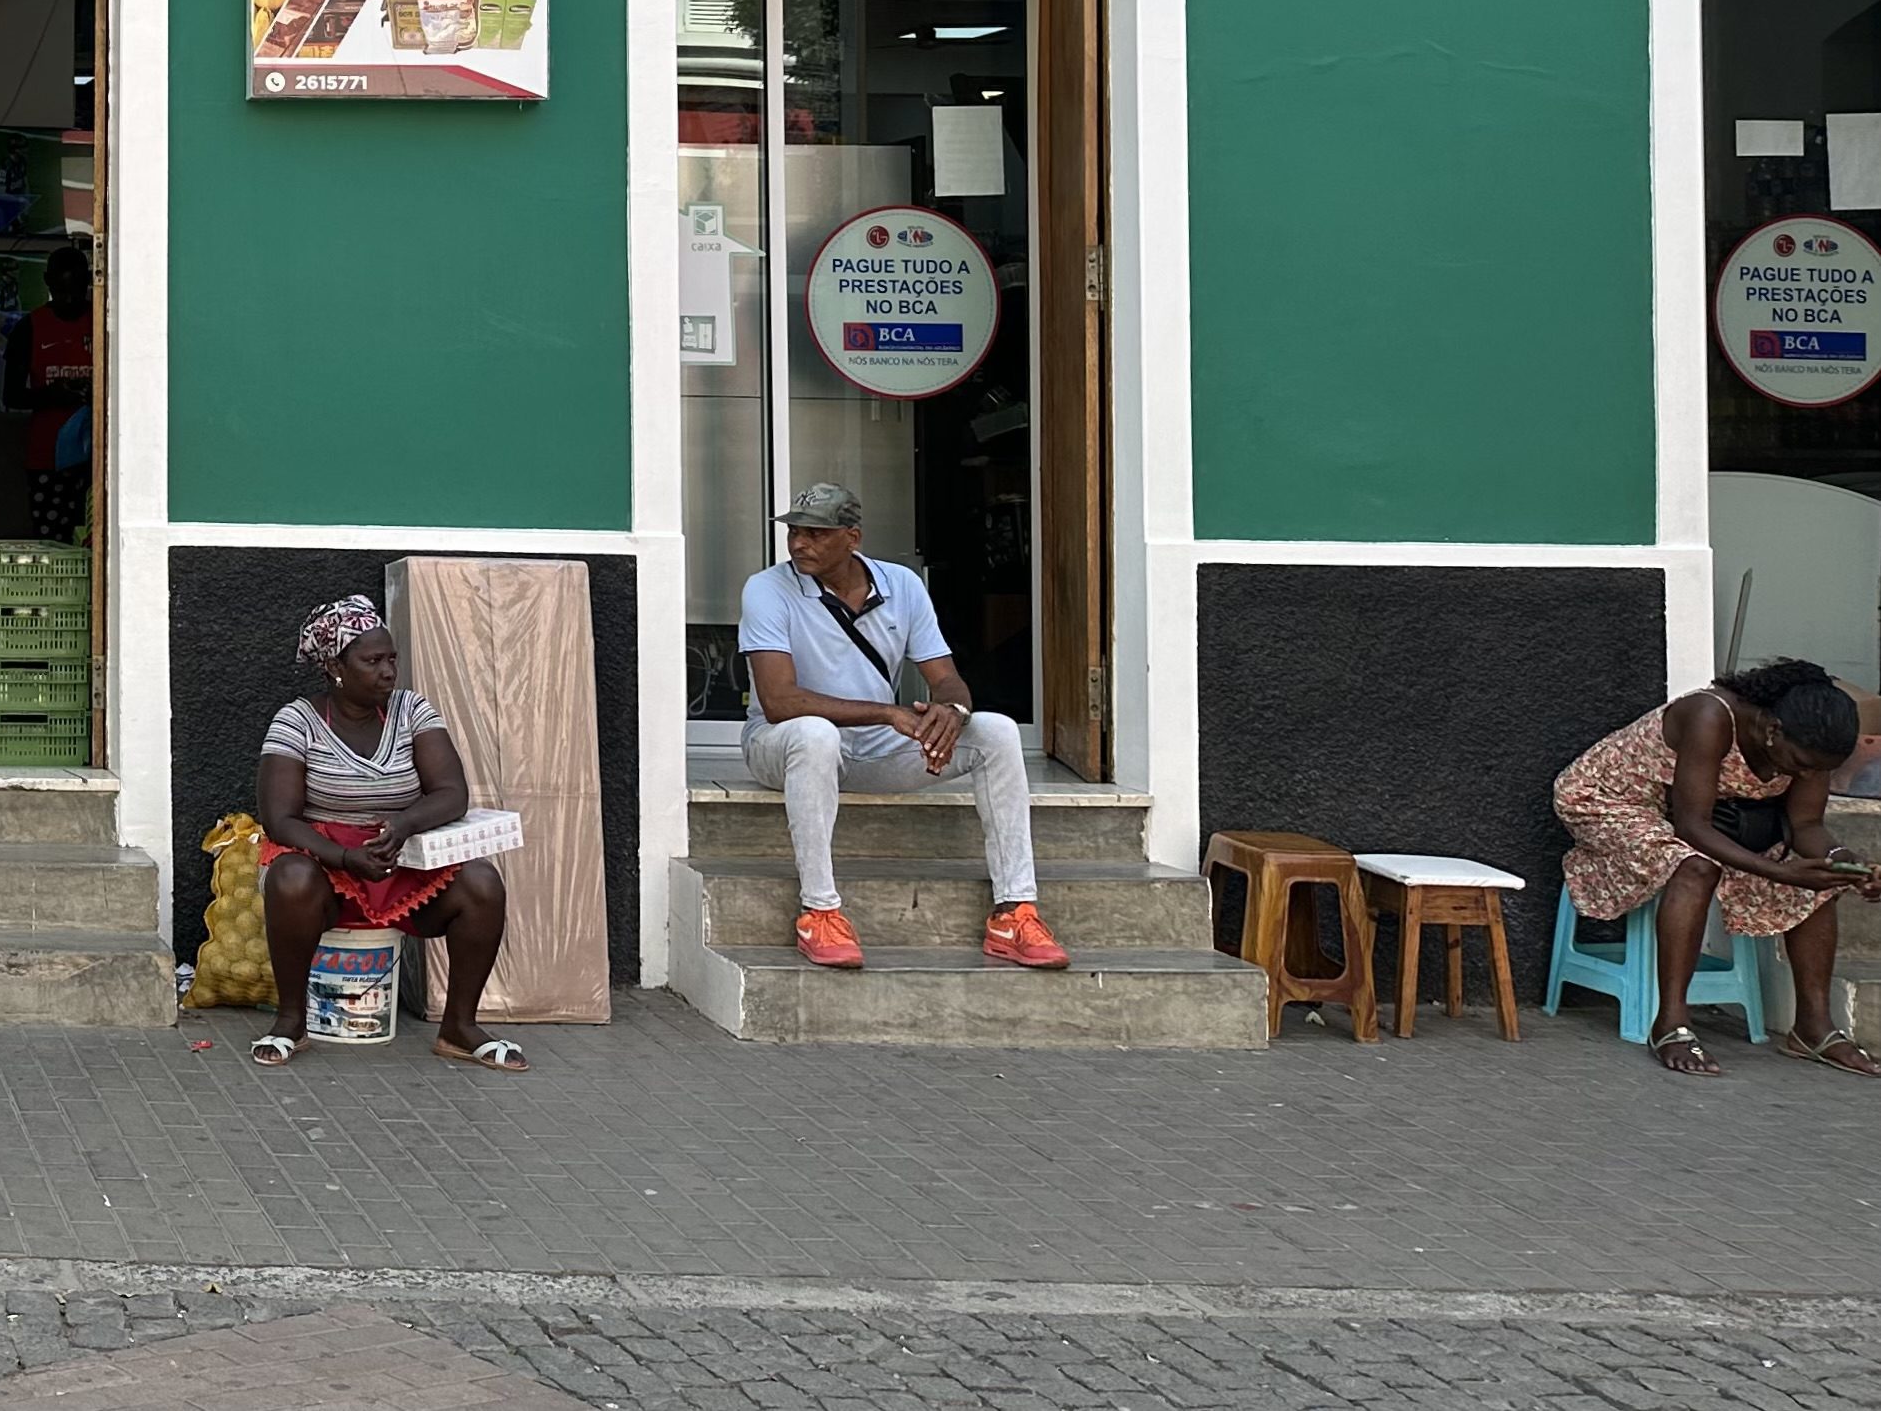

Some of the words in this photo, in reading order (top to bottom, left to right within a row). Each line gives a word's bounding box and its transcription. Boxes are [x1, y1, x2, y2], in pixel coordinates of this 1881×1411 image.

[295, 75, 368, 90] 2615771
[691, 241, 722, 252] caixa
[832, 258, 895, 273] PAGUE
[902, 259, 953, 274] TUDO
[957, 260, 970, 274] A
[1739, 266, 1801, 282] PAGUE
[1807, 268, 1857, 283] TUDO
[1861, 270, 1874, 284] A
[838, 276, 963, 297] PRESTAÇÕES
[1745, 285, 1867, 306] PRESTAÇÕES
[865, 299, 893, 314] NO
[898, 300, 938, 314] BCA
[1771, 308, 1798, 322] NO
[1804, 308, 1842, 323] BCA
[878, 327, 916, 342] BCA
[1784, 335, 1820, 350] BCA
